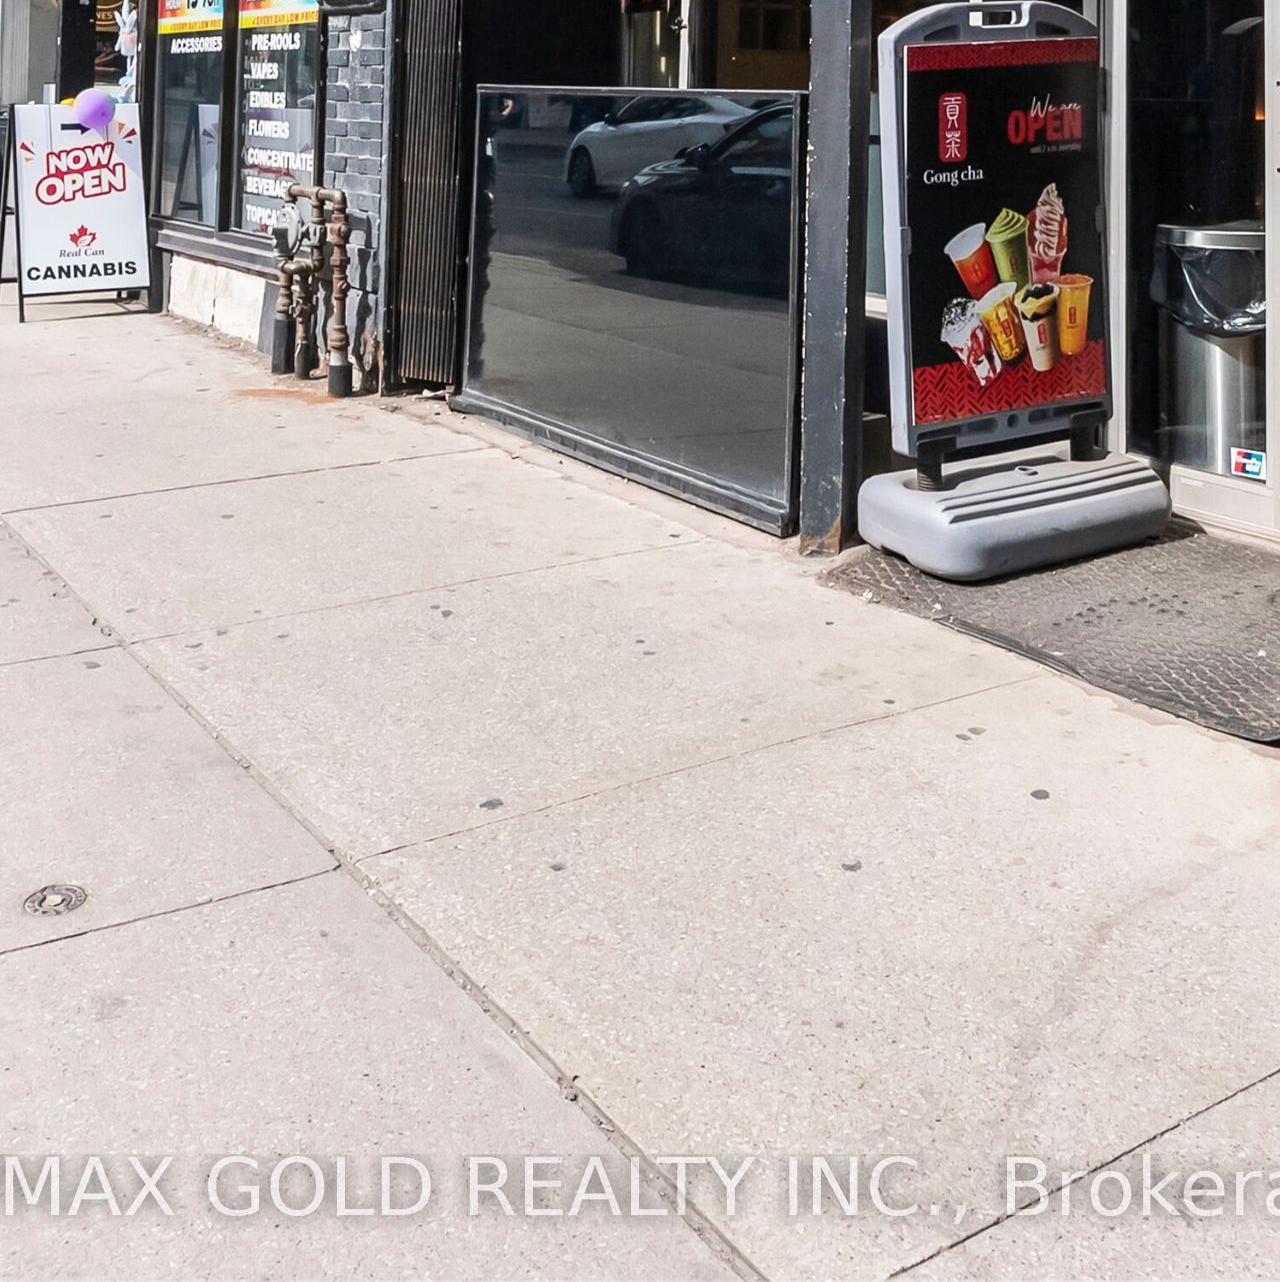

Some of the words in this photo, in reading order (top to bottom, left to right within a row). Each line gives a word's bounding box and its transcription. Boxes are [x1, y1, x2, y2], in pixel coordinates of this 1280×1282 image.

[170, 36, 223, 54] ACCESSORIES
[251, 32, 301, 51] PRE-ROOLS
[250, 62, 279, 80] VAPES
[249, 90, 286, 109] EDIBLES
[1030, 93, 1055, 118] We
[1060, 102, 1082, 111] are
[248, 119, 290, 139] FLOWERS
[1007, 109, 1083, 144] OPEN
[47, 143, 114, 174] NOW
[37, 164, 126, 203] OPEN
[923, 168, 959, 187] Gong
[960, 165, 984, 181] cha
[246, 204, 281, 226] TOPICA
[59, 248, 81, 259] Real
[84, 247, 105, 257] Can
[26, 261, 137, 281] CANNABIS
